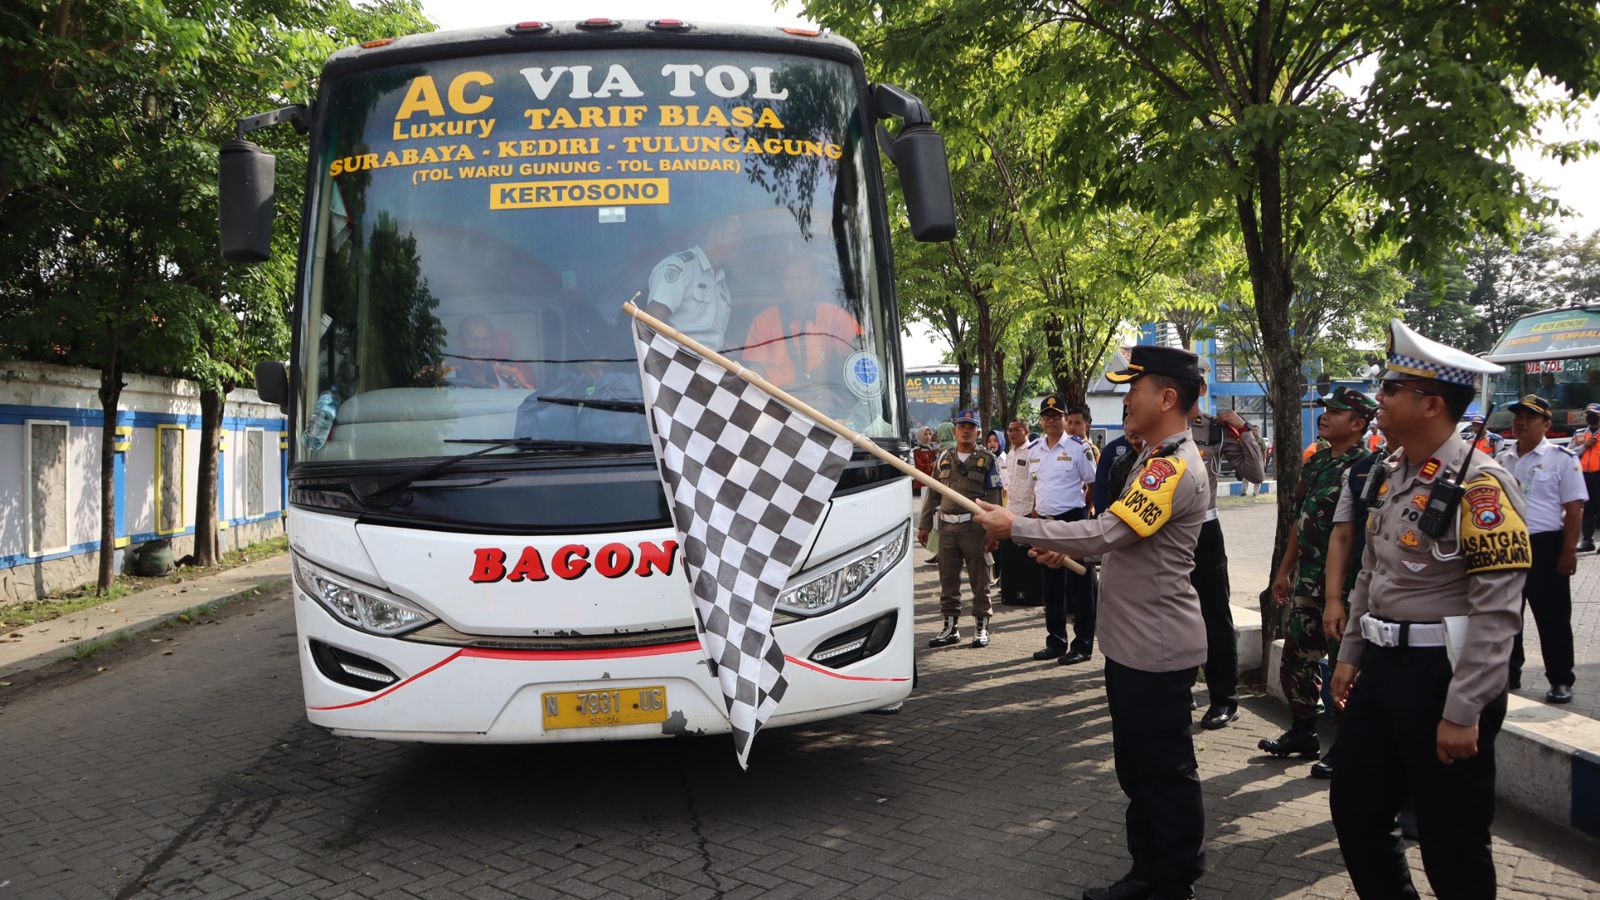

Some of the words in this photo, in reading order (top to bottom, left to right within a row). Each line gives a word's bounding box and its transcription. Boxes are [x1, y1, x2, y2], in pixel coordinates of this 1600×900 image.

[395, 71, 495, 120] AC
[519, 64, 645, 100] VIA
[661, 64, 789, 100] TOL
[393, 118, 496, 141] Luxury
[524, 105, 648, 130] TARIF
[658, 105, 785, 129] BIASA
[329, 144, 475, 176] SURABAYA
[498, 138, 600, 158] KEDIRI
[622, 136, 843, 160] TULUNGAGUNG
[412, 168, 454, 186] (TOL
[459, 164, 514, 179] WARU
[519, 161, 601, 176] GUNUNG
[617, 160, 654, 172] TOL
[659, 159, 741, 174] BANDAR)
[499, 182, 659, 204] KERTOSONO
[1526, 361, 1542, 374] VIA
[1543, 360, 1564, 373] TOL
[907, 378, 921, 386] AC
[926, 377, 946, 385] VIA
[1125, 490, 1148, 513] OPS
[1139, 502, 1162, 526] RES
[469, 539, 684, 583] BAGON
[545, 695, 559, 717] N
[577, 691, 621, 715] 7931
[639, 689, 663, 711] UG
